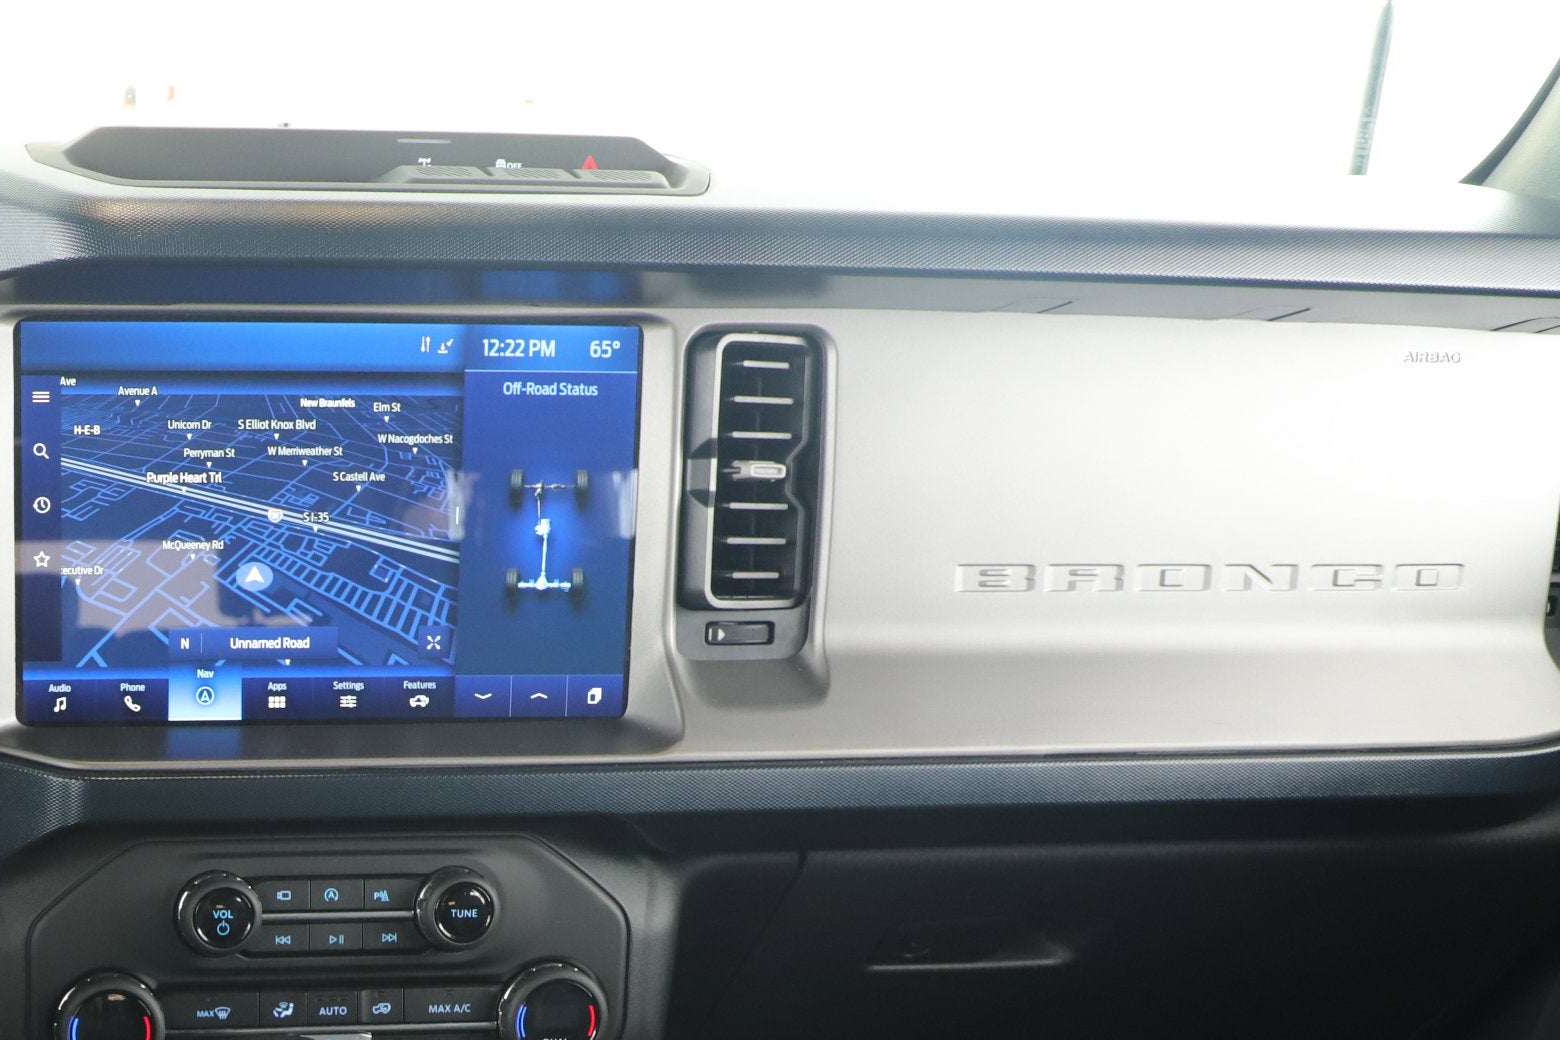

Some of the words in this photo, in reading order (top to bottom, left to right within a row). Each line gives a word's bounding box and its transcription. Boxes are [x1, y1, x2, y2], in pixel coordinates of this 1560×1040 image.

[482, 338, 526, 358] 12:22
[528, 340, 556, 358] PM
[1403, 351, 1461, 364] AIRBAG
[60, 377, 76, 386] Ave
[118, 386, 150, 396] Avenue
[503, 381, 558, 397] Off-Road
[559, 382, 598, 397] Status
[300, 398, 317, 407] New
[319, 398, 355, 407] Braunfels
[373, 402, 389, 412] Elm
[390, 402, 401, 412] St
[167, 420, 199, 430] Unicorn
[200, 420, 212, 430] Dr
[238, 420, 244, 430] S
[245, 420, 269, 430] Elliot
[270, 420, 294, 430] Knox
[296, 420, 316, 430] Blvd
[73, 425, 101, 436] H-E-B
[378, 434, 386, 444] W
[388, 434, 442, 446] Nacogdoches
[443, 434, 453, 444] St
[183, 447, 224, 460] Perryman
[226, 447, 235, 458] St
[267, 447, 276, 456] W
[277, 447, 332, 456] Merriweather
[333, 447, 343, 456] St
[146, 472, 178, 485] Purple
[179, 472, 207, 484] Heart
[209, 472, 222, 483] Trl
[333, 472, 338, 482] S
[339, 472, 367, 482] Castell
[369, 472, 385, 482] Ave
[303, 512, 309, 523] S
[162, 540, 211, 552] McQueeney
[213, 540, 224, 550] Rd
[60, 565, 92, 576] ecutive
[93, 565, 104, 576] Dr
[954, 563, 1466, 593] BRONCO
[180, 638, 190, 650] N
[230, 638, 281, 650] Unnamed
[284, 638, 310, 650] Road
[197, 669, 214, 679] Nav
[48, 683, 71, 693] Audio
[120, 682, 145, 693] Phone
[267, 681, 287, 693] Apps
[333, 681, 364, 692] Settings
[403, 680, 436, 690] Features
[212, 910, 234, 919] VOL
[451, 908, 478, 918] TUNE
[196, 1009, 214, 1018] MAX
[318, 1006, 348, 1016] AUTO
[428, 1004, 452, 1013] MAX
[454, 1004, 471, 1013] A/C
